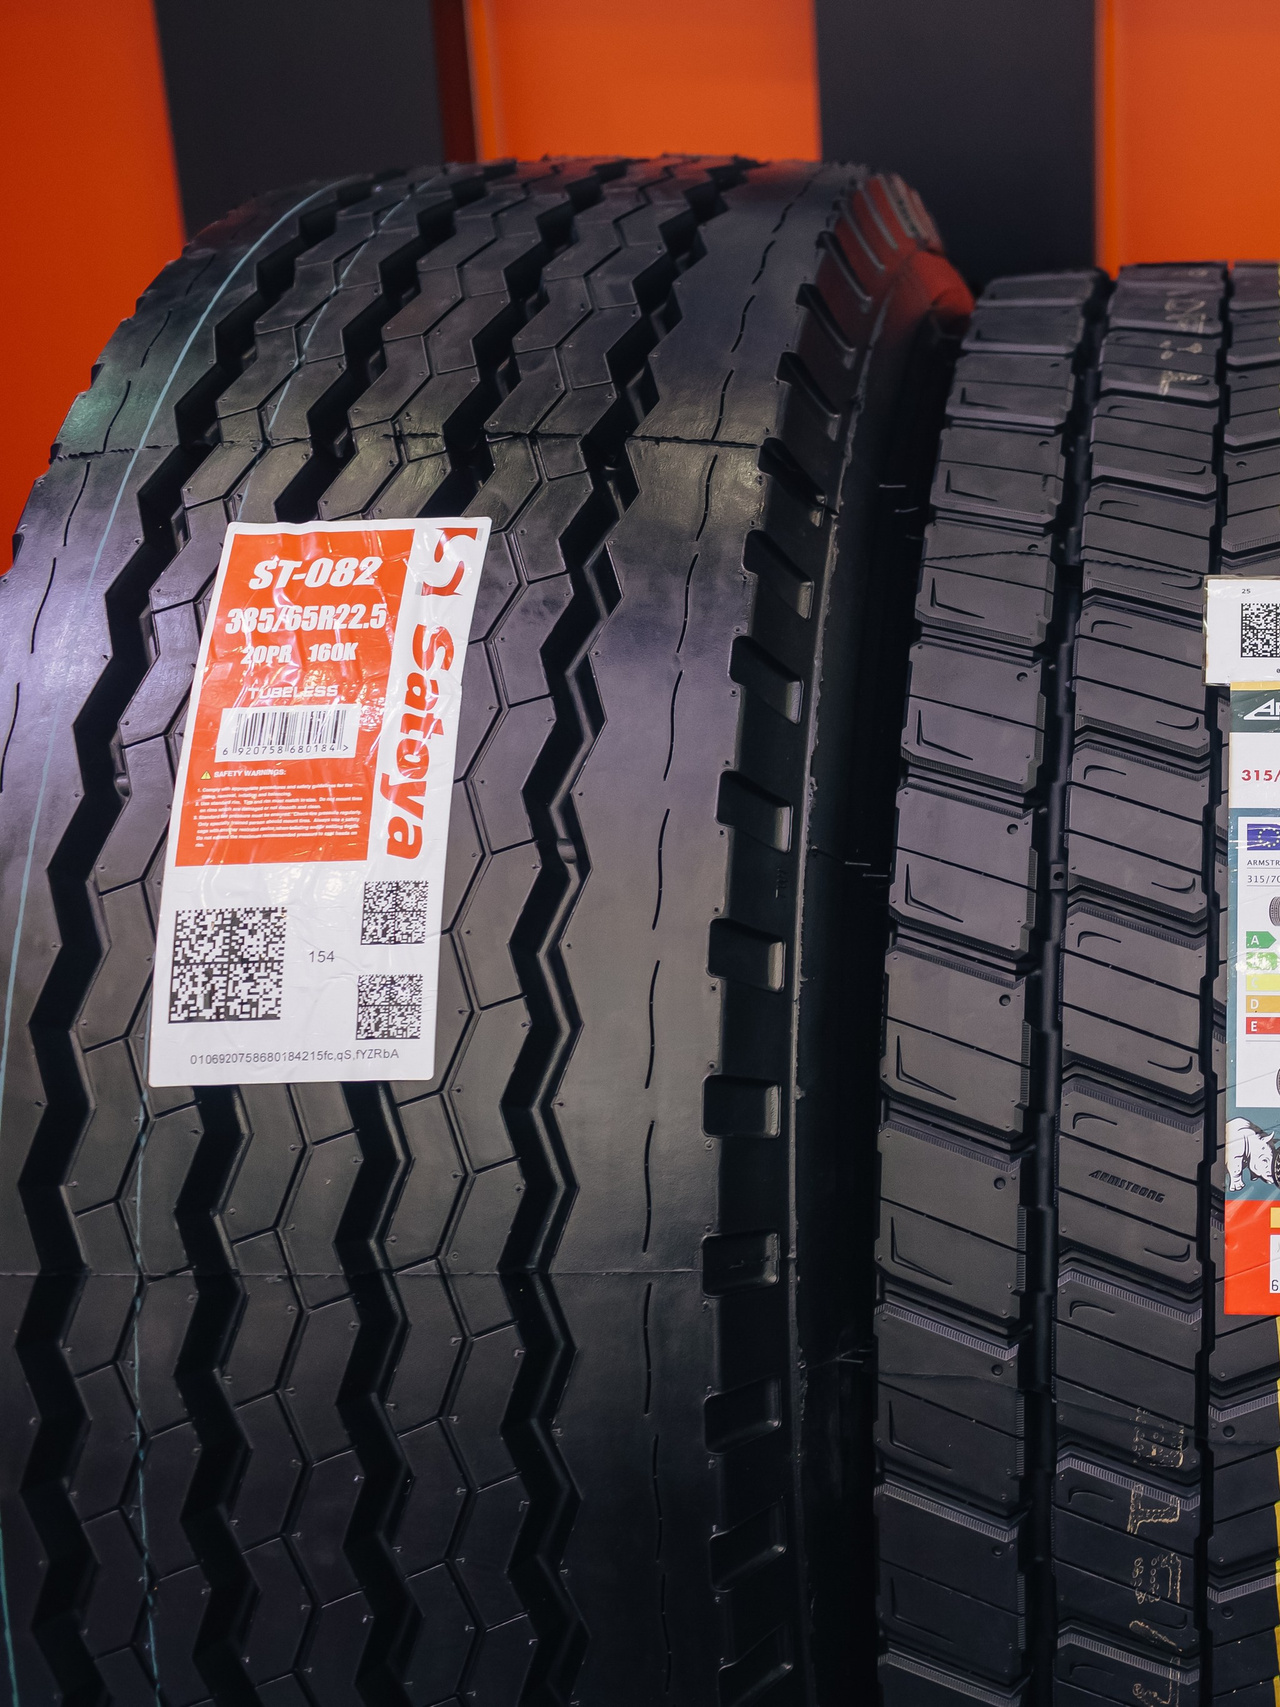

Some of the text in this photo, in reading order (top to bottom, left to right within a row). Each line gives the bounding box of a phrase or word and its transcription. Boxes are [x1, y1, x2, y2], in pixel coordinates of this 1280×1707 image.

[249, 557, 383, 590] ST-082
[225, 603, 387, 634] 385/65R22.5
[241, 643, 359, 664] 20PR 160K
[248, 685, 338, 699] TUBELESS
[379, 623, 456, 860] Satoya
[223, 744, 335, 756] 6 920758 680184
[1251, 936, 1259, 945] A
[309, 951, 335, 963] 154
[1251, 1000, 1259, 1009] D
[1251, 1021, 1257, 1031] E
[1089, 1170, 1165, 1203] ARMSTRONG
[1271, 1280, 1279, 1291] 6
